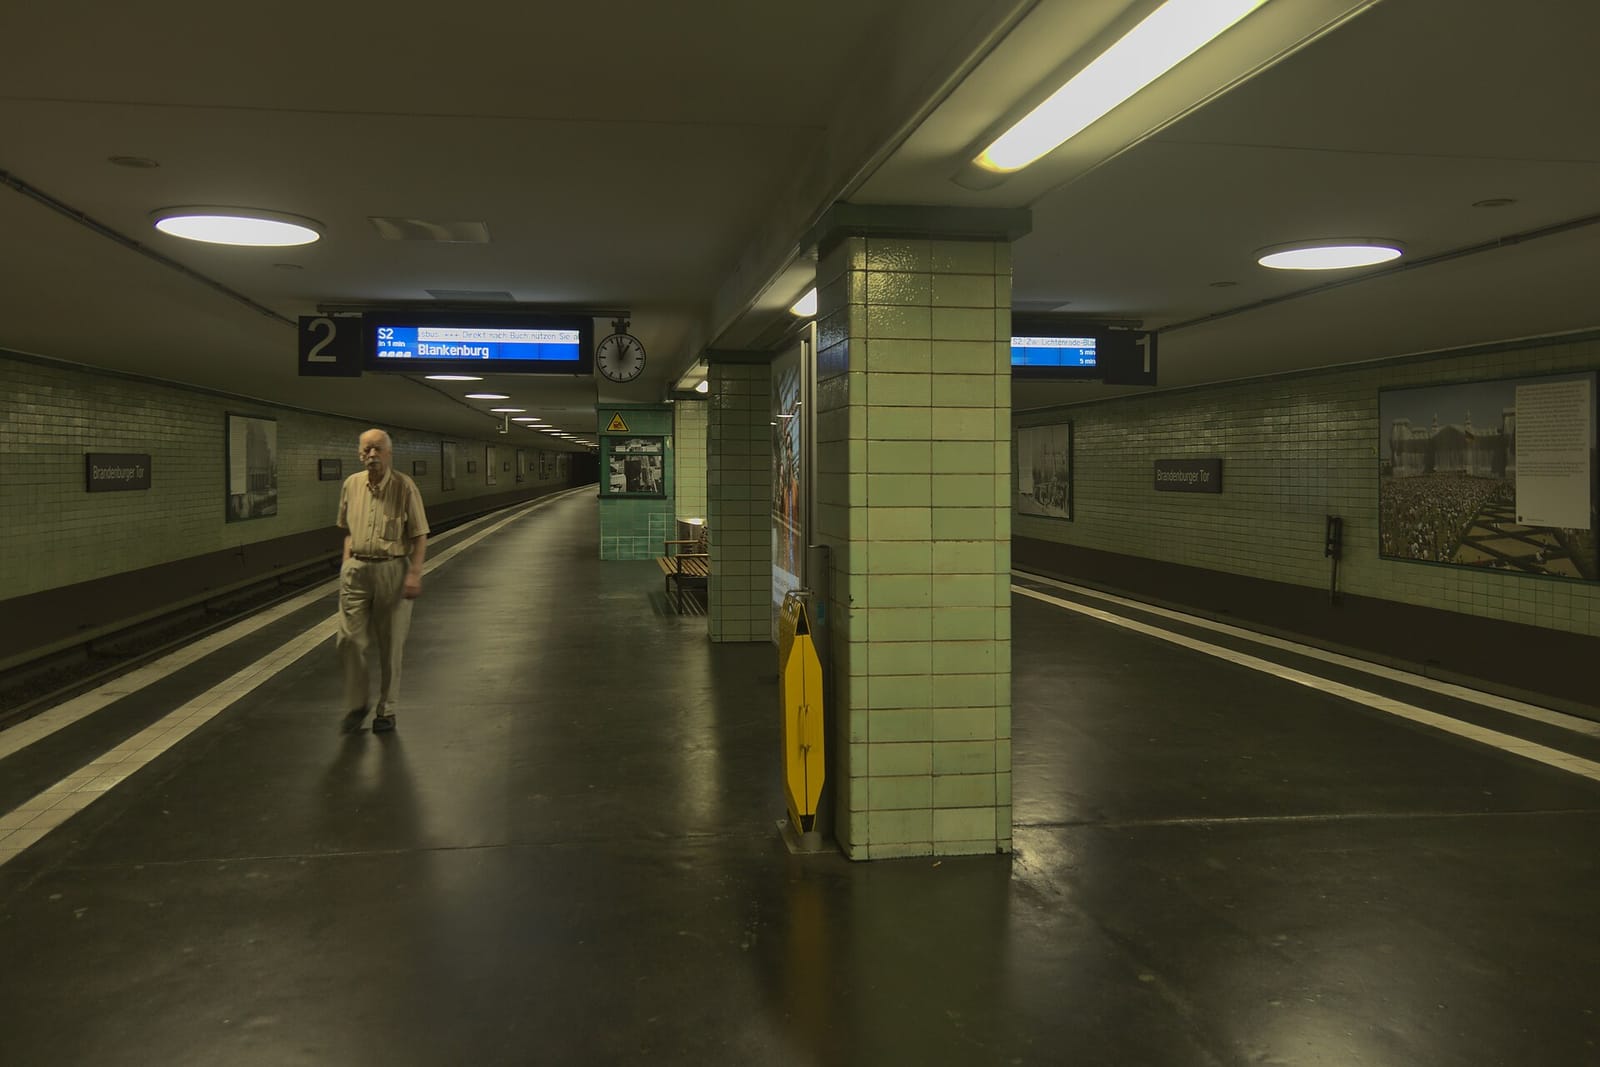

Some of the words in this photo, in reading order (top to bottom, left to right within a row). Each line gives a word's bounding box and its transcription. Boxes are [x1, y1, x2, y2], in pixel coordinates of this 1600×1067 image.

[308, 318, 337, 362] 2
[378, 327, 393, 339] S2
[418, 344, 489, 359] Blankenburg
[1135, 334, 1151, 372] 1
[93, 465, 135, 482] Brandenburger
[136, 465, 145, 479] Tor
[1157, 469, 1198, 485] Brandenburger
[1200, 469, 1210, 483] Tor
